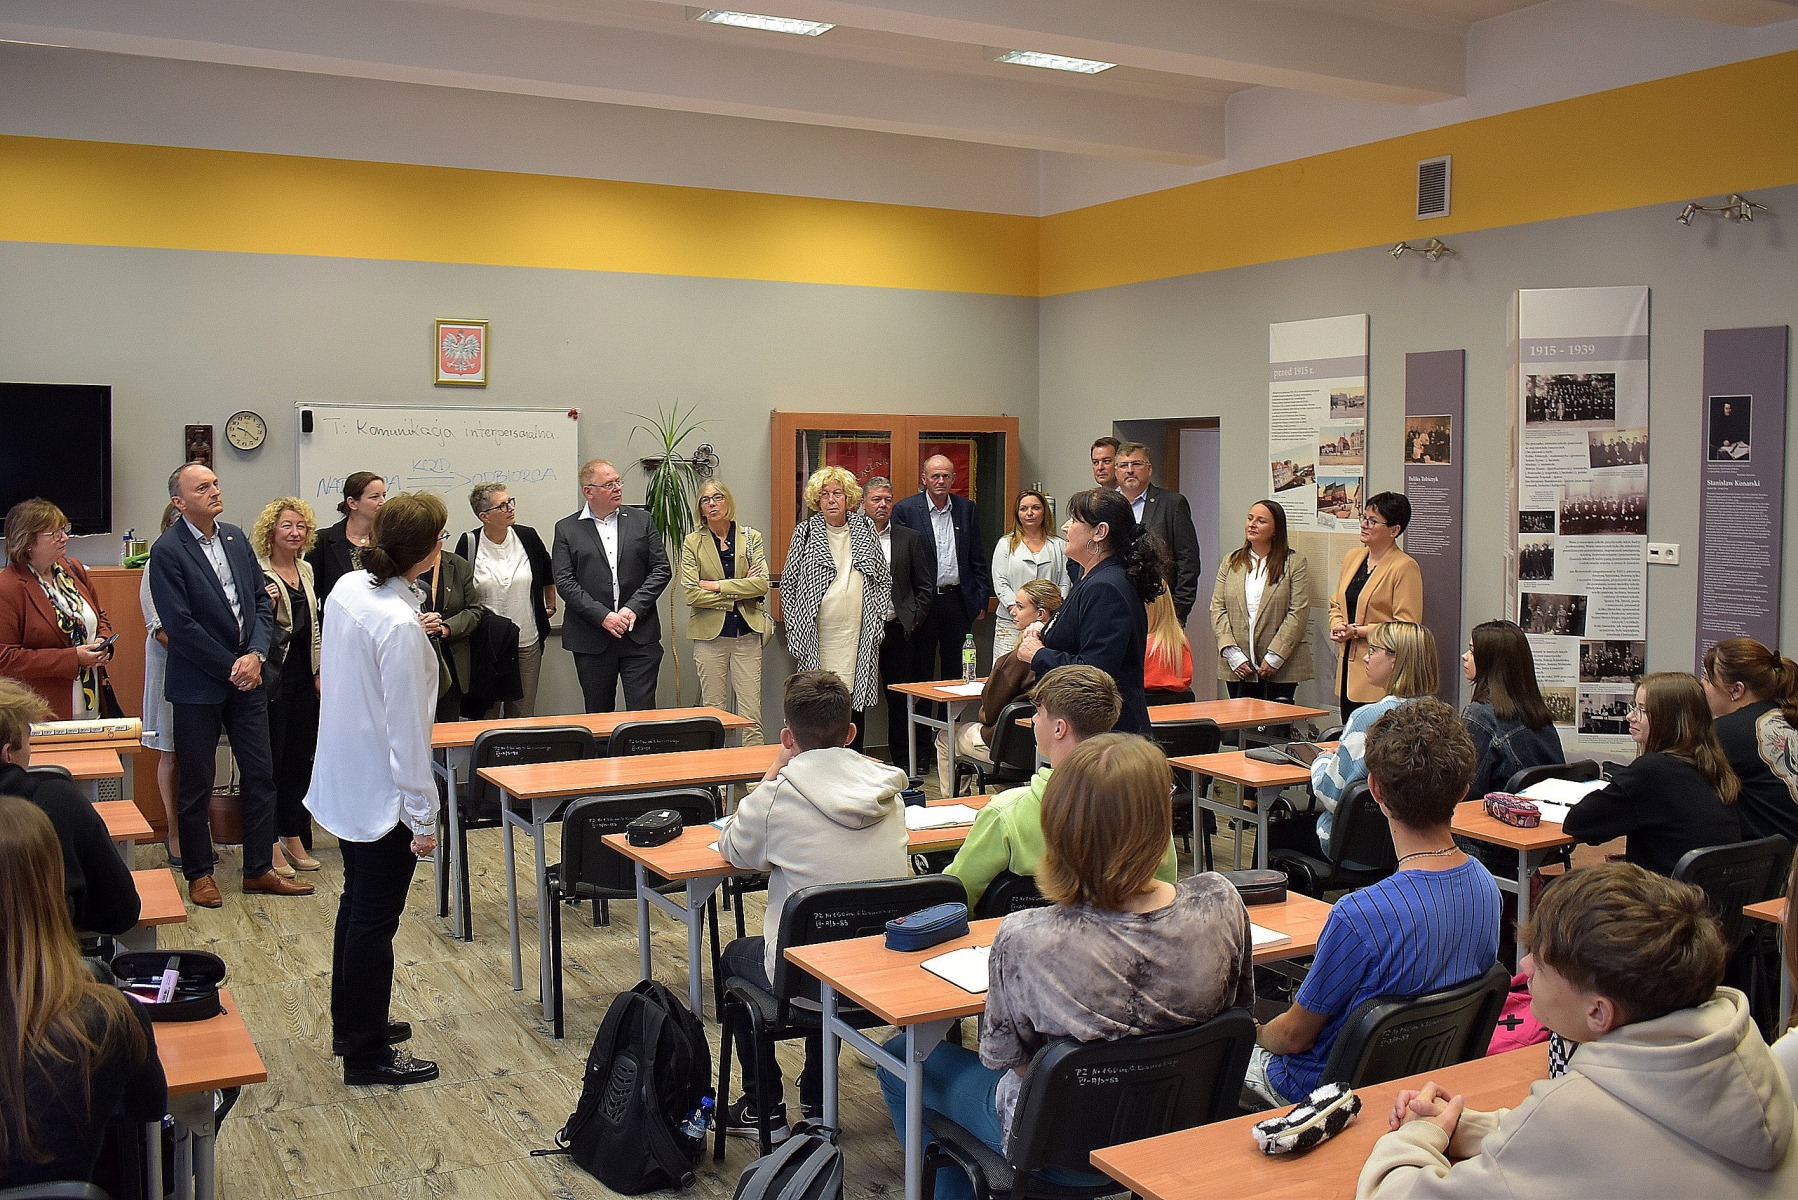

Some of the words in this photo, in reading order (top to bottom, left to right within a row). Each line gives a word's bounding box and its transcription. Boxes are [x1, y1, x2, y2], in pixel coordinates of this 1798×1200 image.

[1529, 345, 1557, 356] 1915
[1568, 344, 1596, 356] 1939
[1273, 366, 1293, 380] przed
[1294, 366, 1309, 376] 1915
[1310, 367, 1315, 375] r.
[356, 418, 457, 447] Komunikacja
[1706, 479, 1733, 487] Stanisław
[1734, 480, 1760, 488] Konarski
